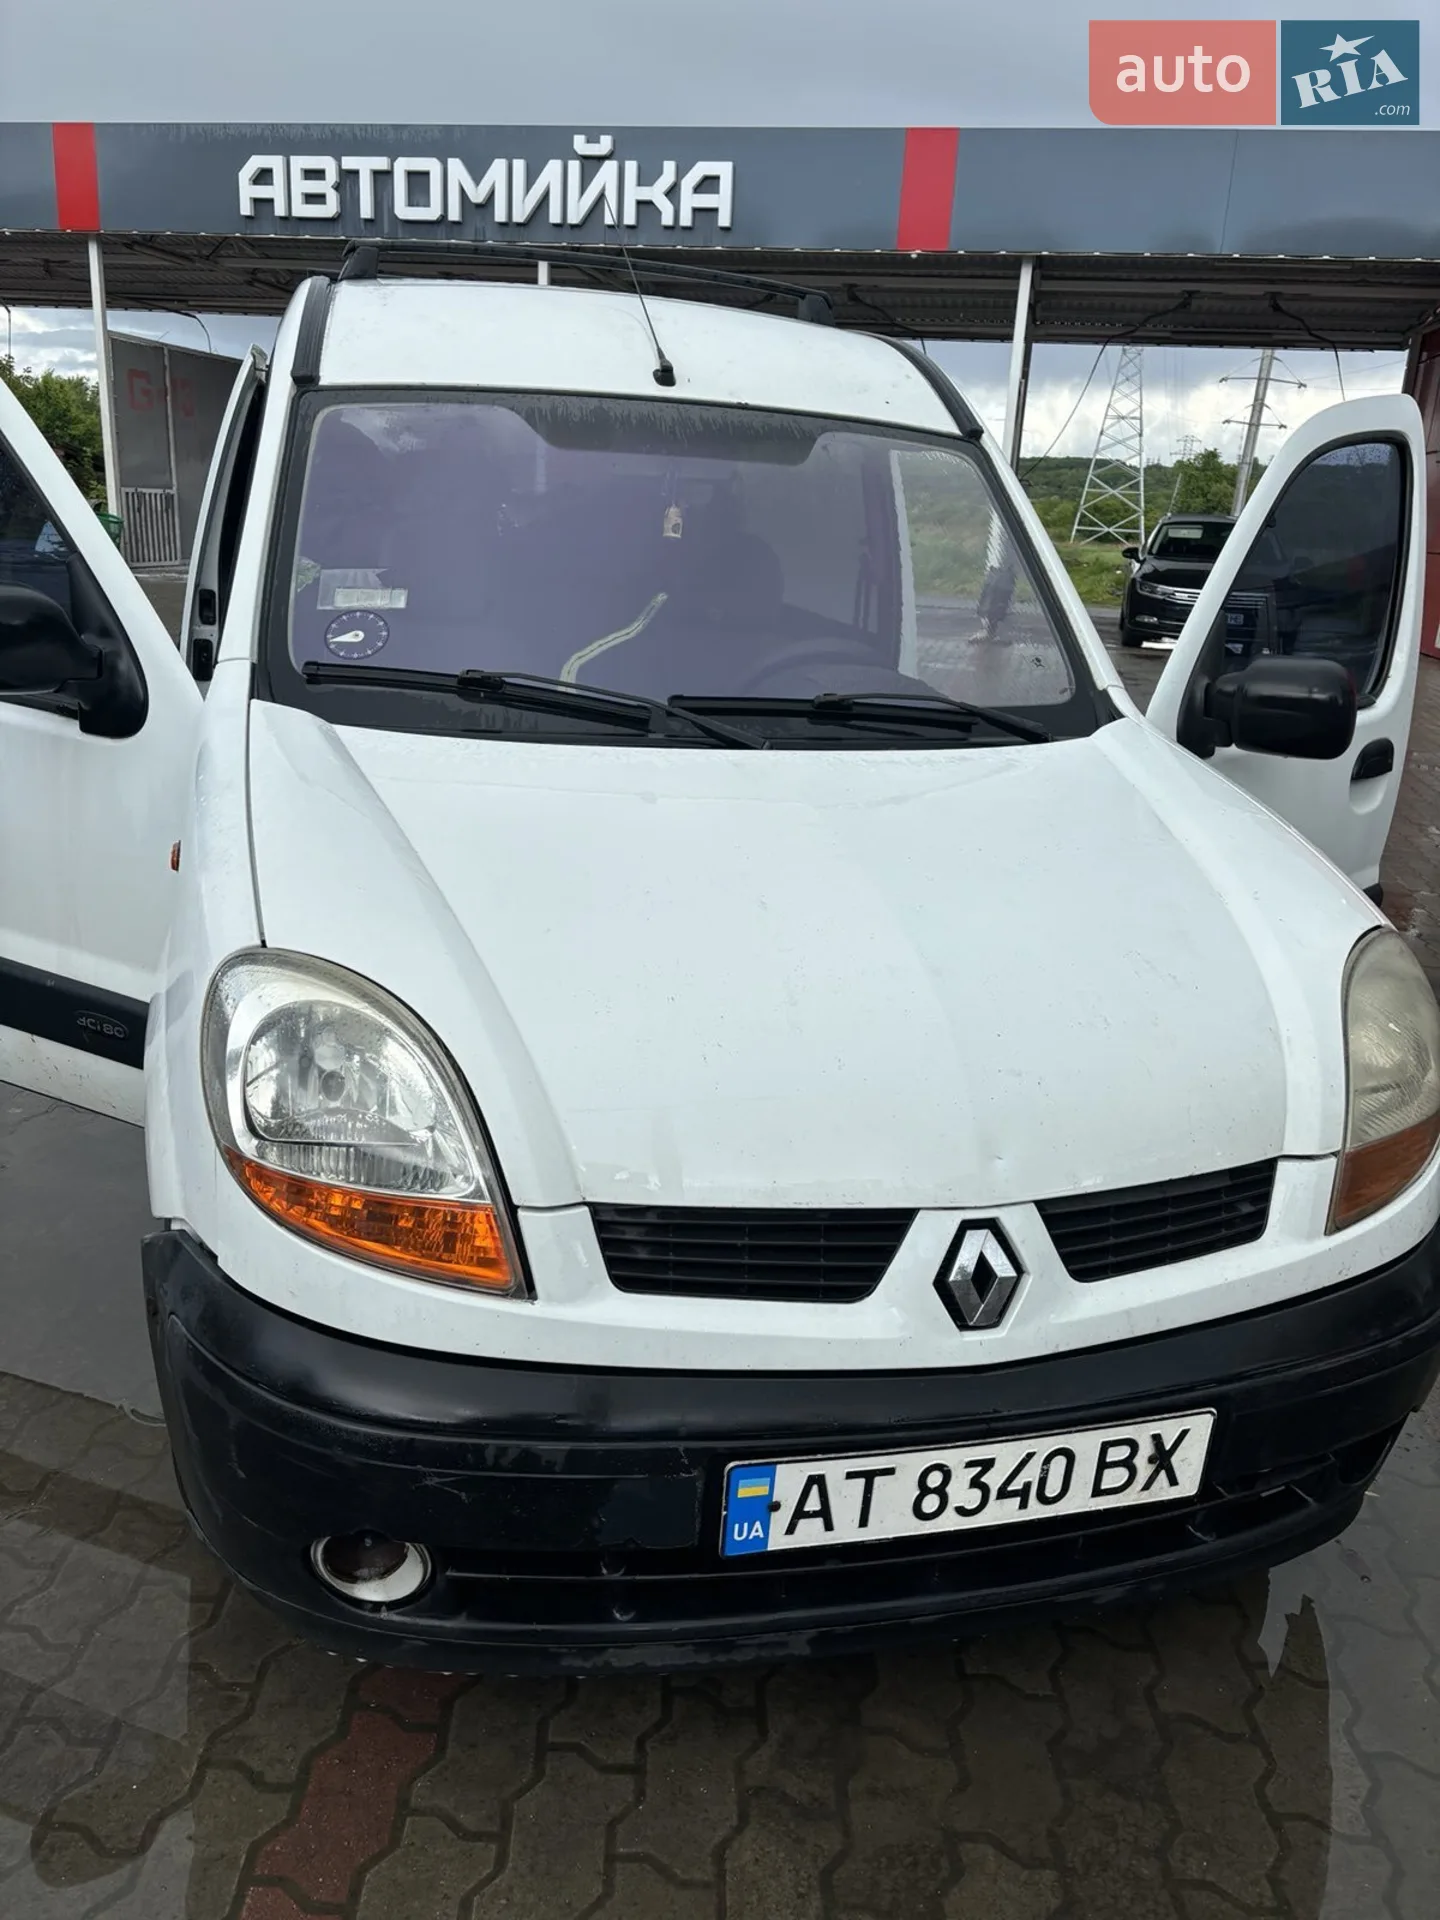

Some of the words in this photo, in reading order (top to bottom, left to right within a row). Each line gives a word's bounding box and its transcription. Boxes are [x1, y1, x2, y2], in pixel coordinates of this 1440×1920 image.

[238, 134, 734, 230] АВТОМИЙКА
[784, 1466, 896, 1536] AT
[911, 1446, 1077, 1522] 8340
[1091, 1427, 1192, 1499] BX
[732, 1520, 764, 1542] UA
